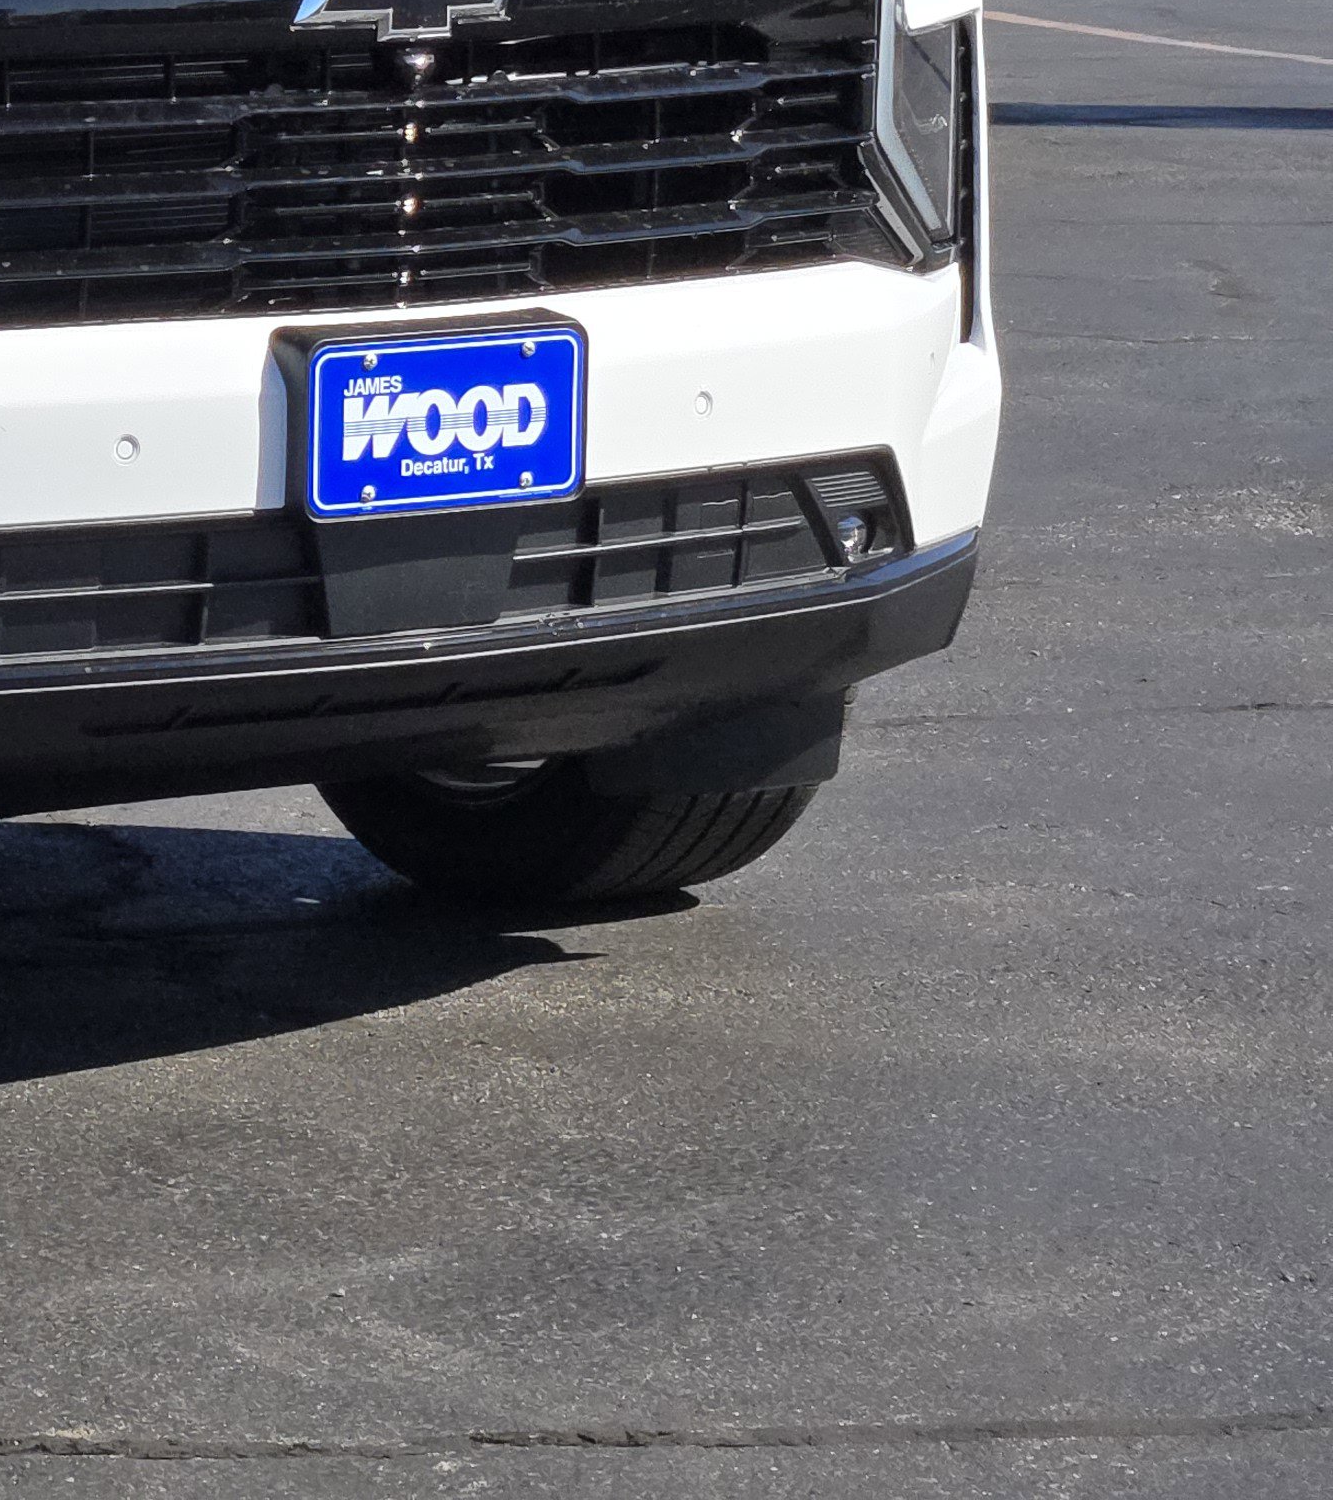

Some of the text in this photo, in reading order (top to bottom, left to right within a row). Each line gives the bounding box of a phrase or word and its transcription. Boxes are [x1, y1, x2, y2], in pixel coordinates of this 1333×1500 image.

[343, 375, 403, 397] JAMES
[342, 383, 547, 461] WOOD
[400, 453, 495, 477] Decatur, Tx
